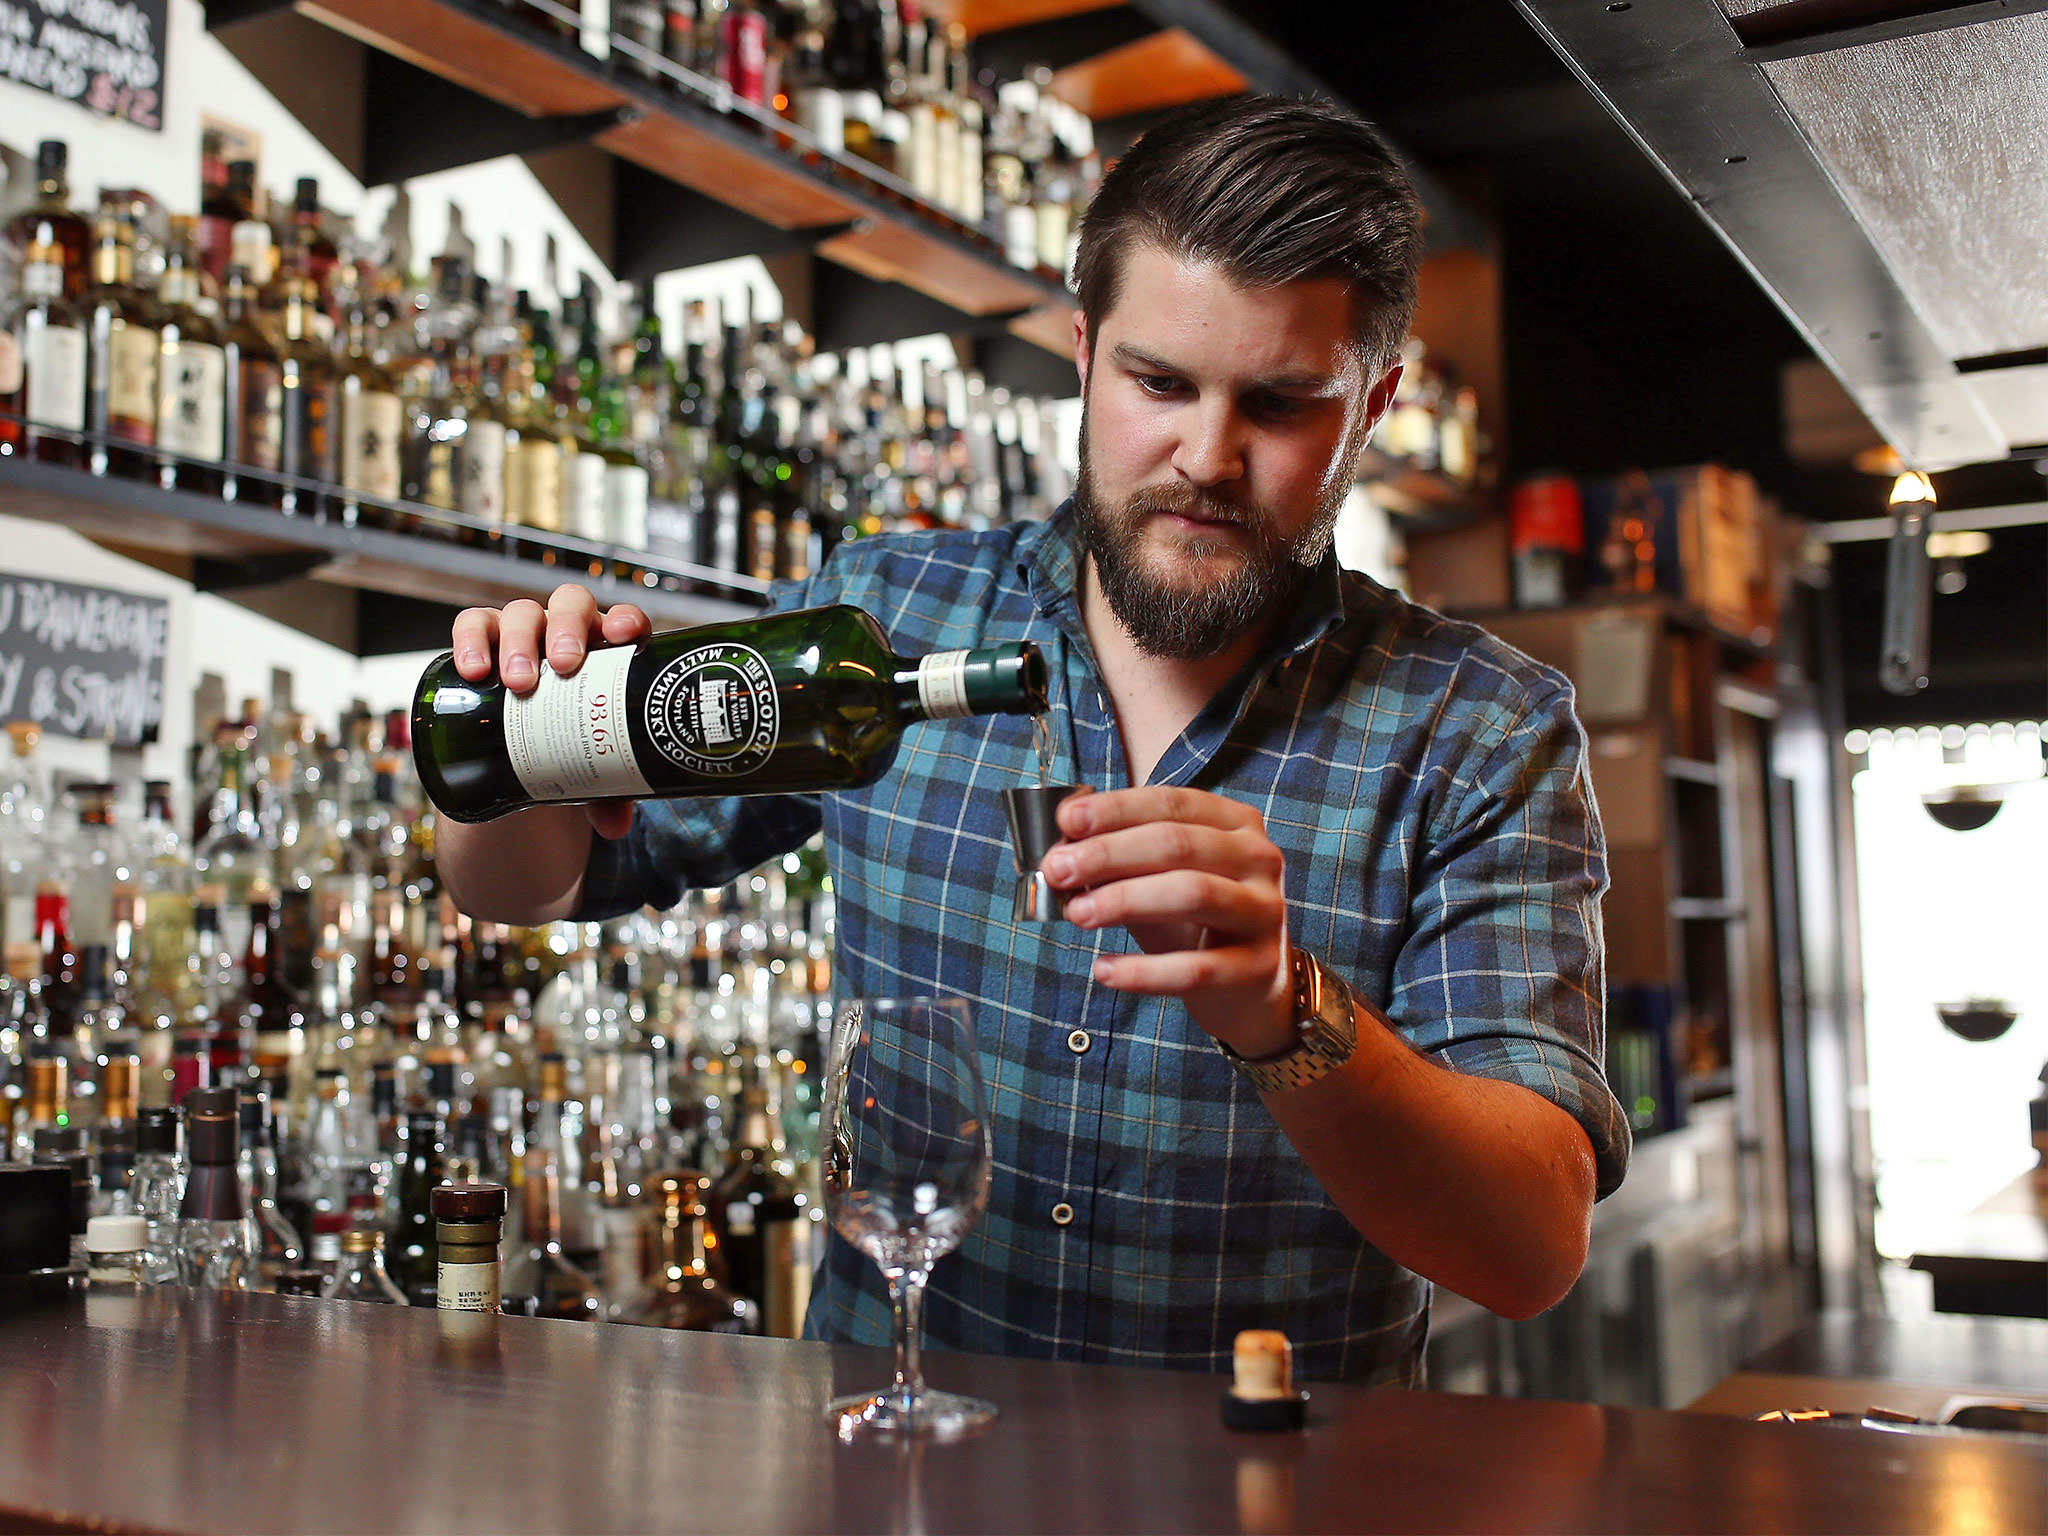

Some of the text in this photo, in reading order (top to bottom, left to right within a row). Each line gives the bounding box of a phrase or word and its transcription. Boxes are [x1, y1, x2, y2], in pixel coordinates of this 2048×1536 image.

[577, 672, 588, 704] Hickory
[650, 648, 734, 773] MALT WHISKY SOCIETY
[673, 685, 695, 744] SCOTLAND
[728, 680, 744, 738] THE VAULTS
[579, 707, 588, 738] smoked
[589, 695, 614, 755] 93.65
[752, 680, 774, 756] SCOTCH
[582, 740, 593, 758] BBQ
